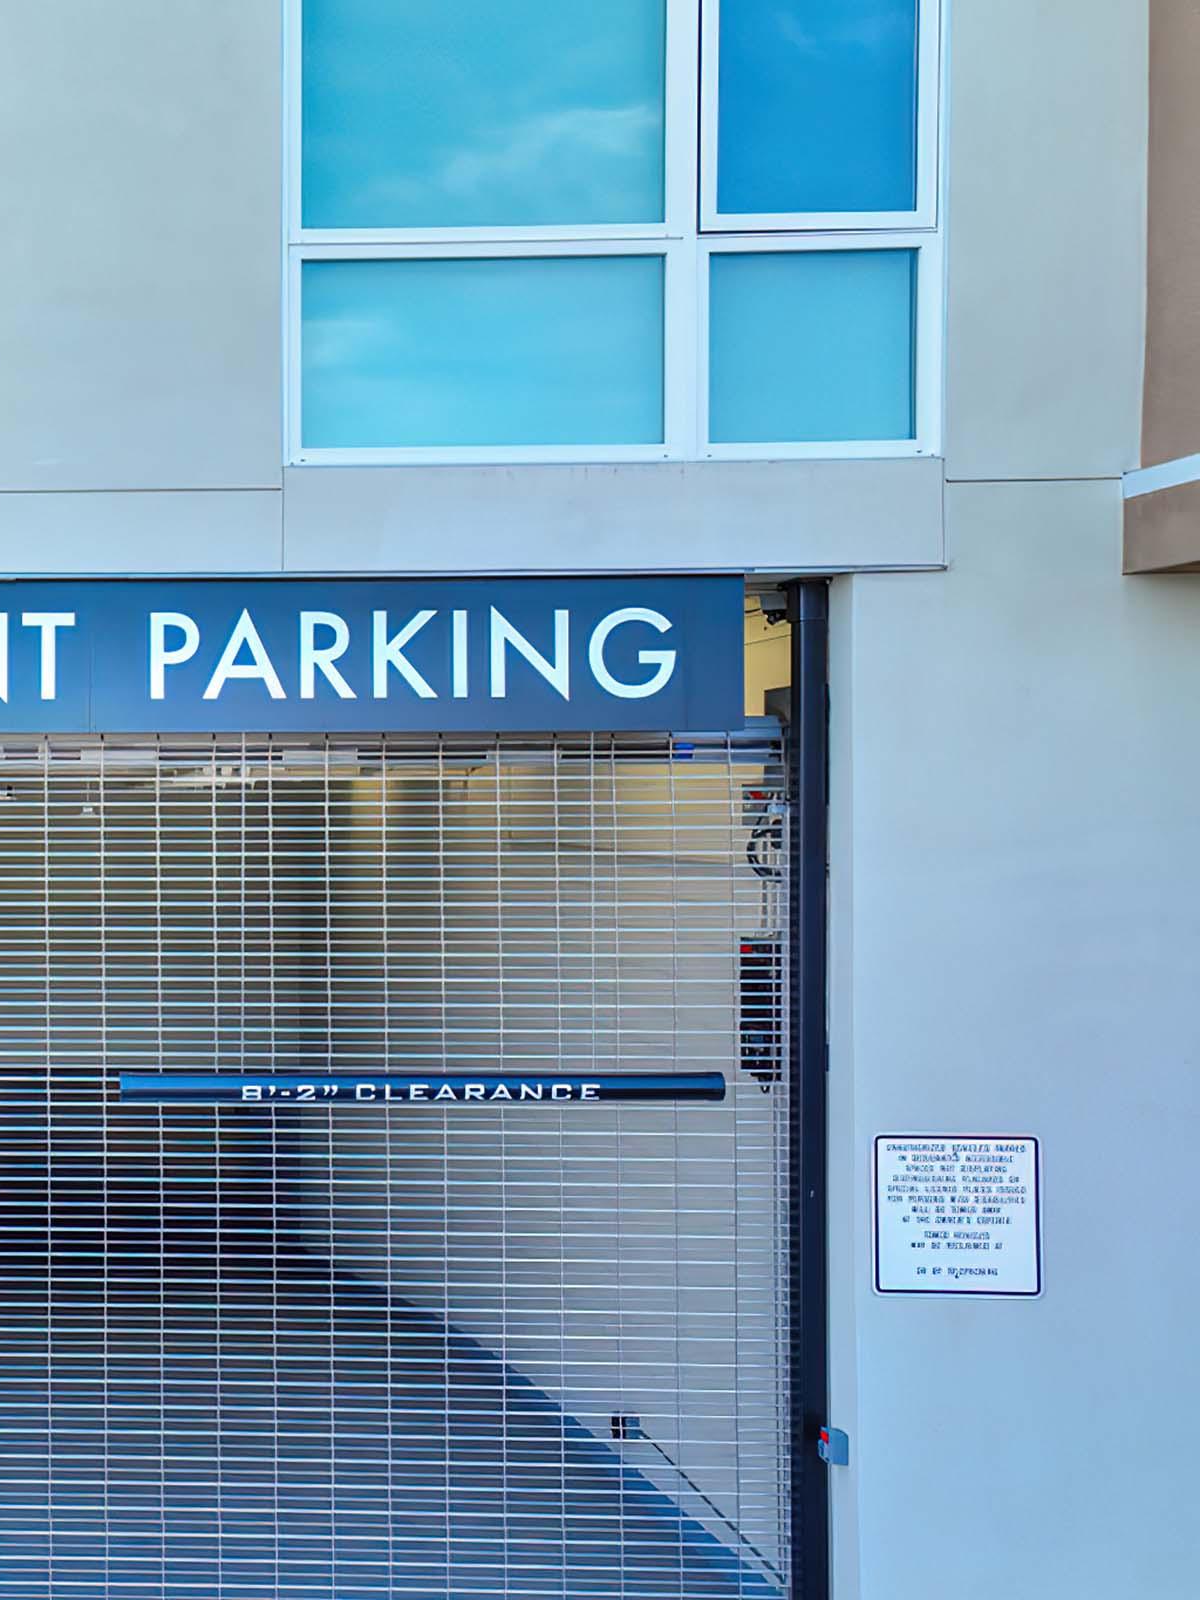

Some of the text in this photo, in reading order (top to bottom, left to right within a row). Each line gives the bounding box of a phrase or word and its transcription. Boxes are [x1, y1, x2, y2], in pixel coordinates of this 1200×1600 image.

[150, 606, 678, 702] PARKING
[240, 1083, 602, 1101] 8'-2" CLEARANCE
